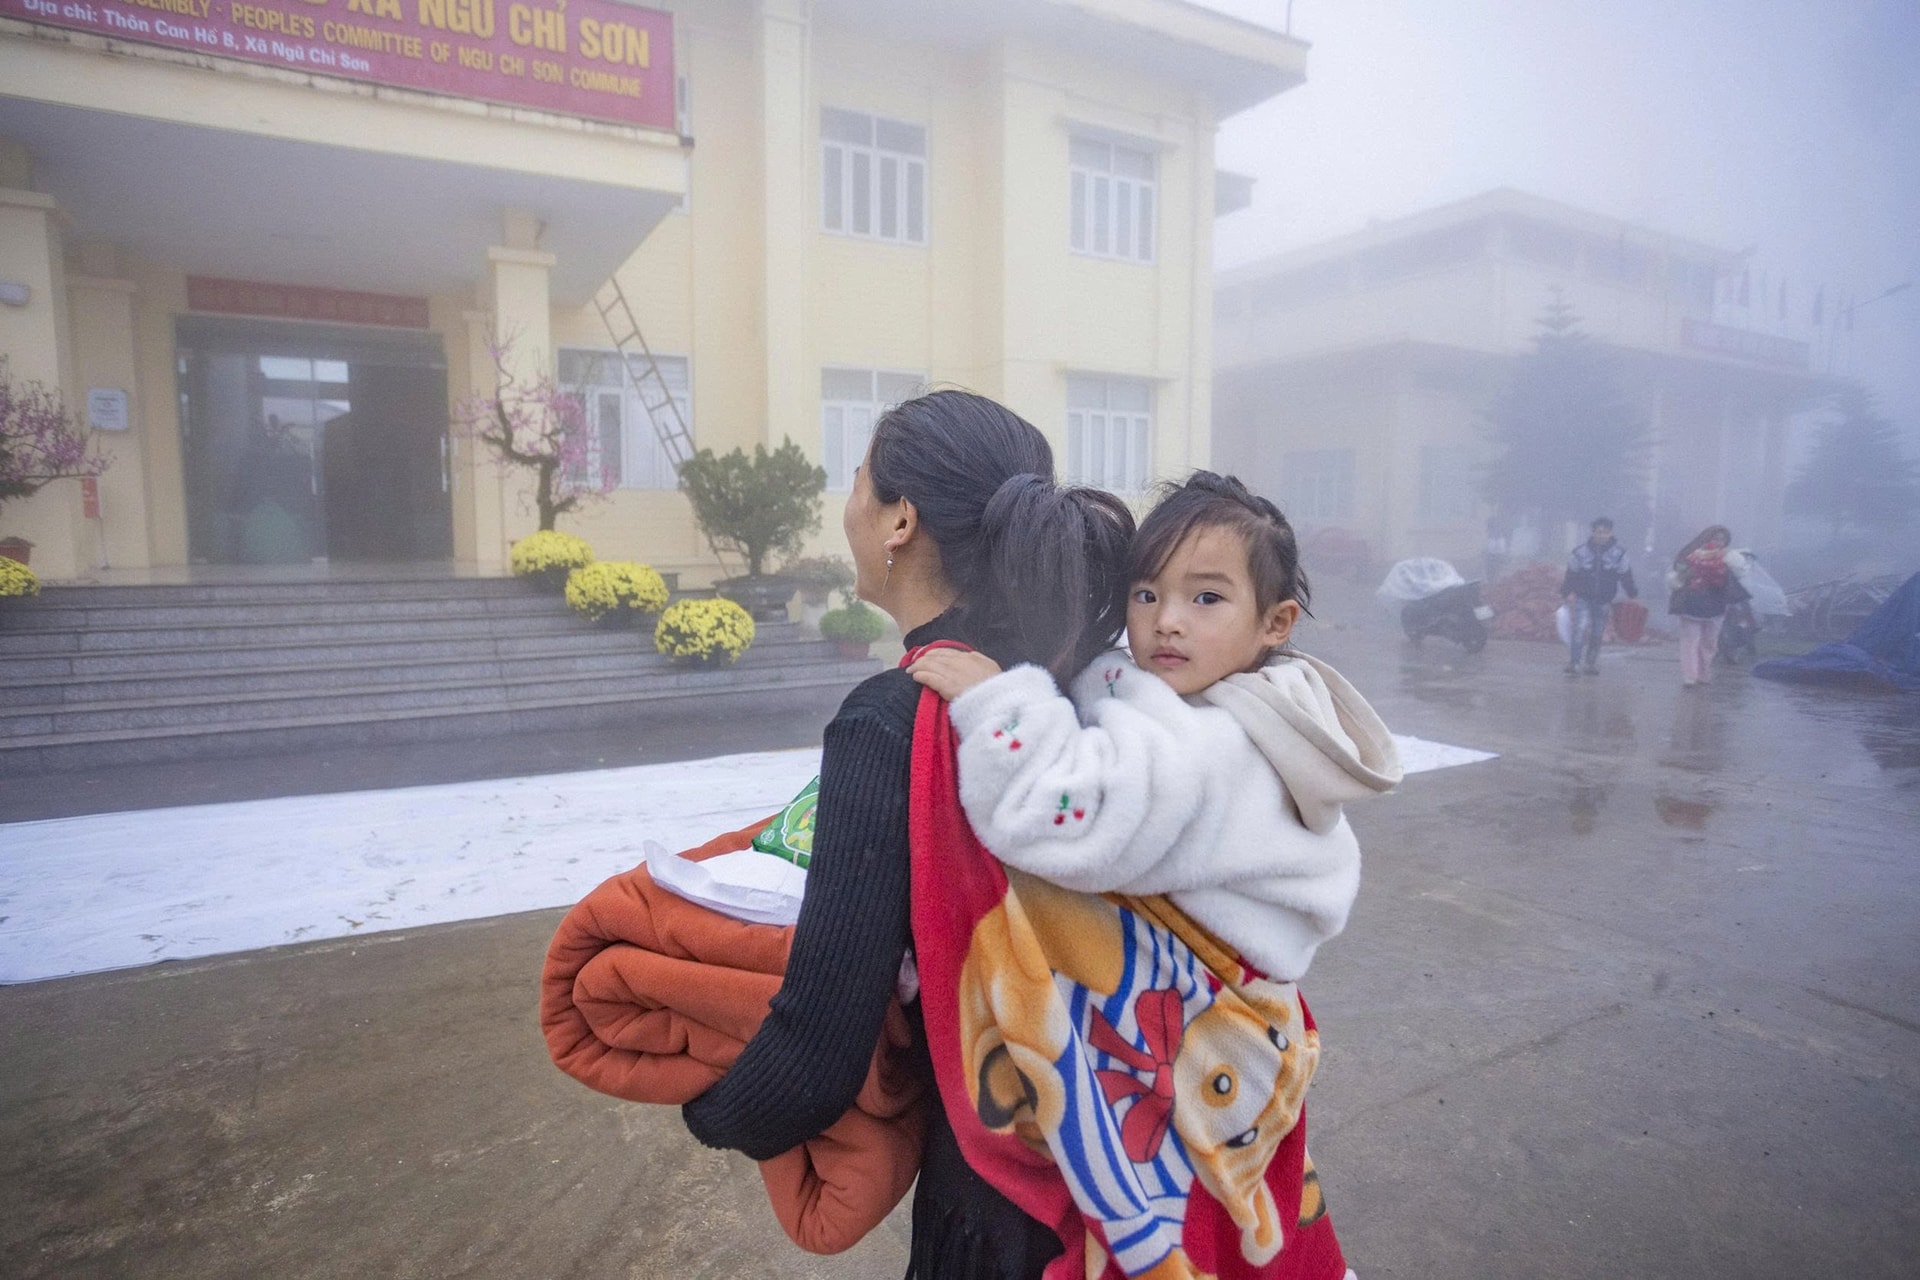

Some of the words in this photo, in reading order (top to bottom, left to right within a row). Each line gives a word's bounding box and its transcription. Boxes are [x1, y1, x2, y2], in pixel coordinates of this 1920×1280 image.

[102, 8, 150, 33] Thôn
[154, 18, 190, 41] Can
[222, 31, 240, 50] B,
[231, 2, 316, 39] PEOPLE'S
[322, 19, 423, 59] COMMITTEE
[429, 39, 451, 64] OF
[457, 45, 494, 71] NGU
[499, 53, 525, 79] CHI
[531, 59, 565, 85] SON
